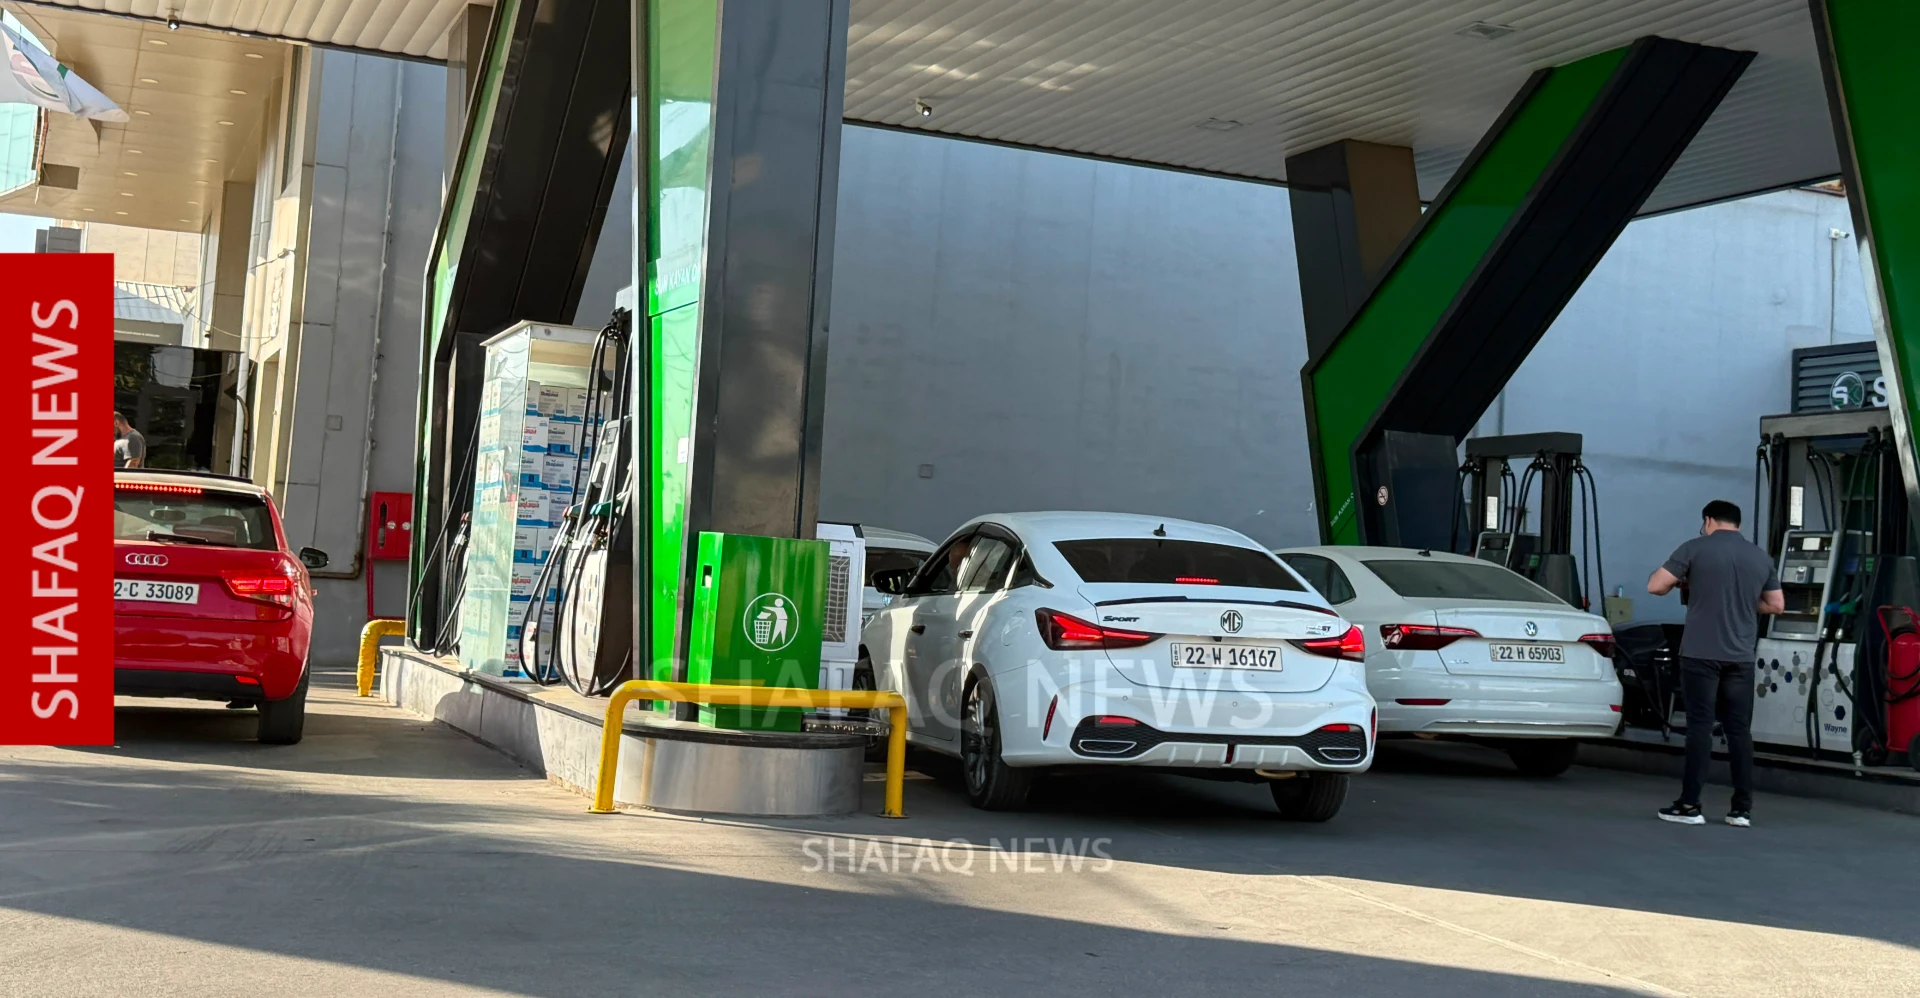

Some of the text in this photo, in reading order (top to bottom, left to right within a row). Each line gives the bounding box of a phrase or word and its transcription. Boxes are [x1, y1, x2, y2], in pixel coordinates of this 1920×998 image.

[129, 582, 139, 597] C
[145, 583, 194, 601] 33089
[1221, 611, 1243, 633] MG
[1185, 647, 1277, 667] 22 W 16167
[1499, 646, 1513, 660] 22
[1516, 647, 1525, 660] H
[1528, 647, 1561, 661] 65903
[1824, 723, 1848, 734] Wayne
